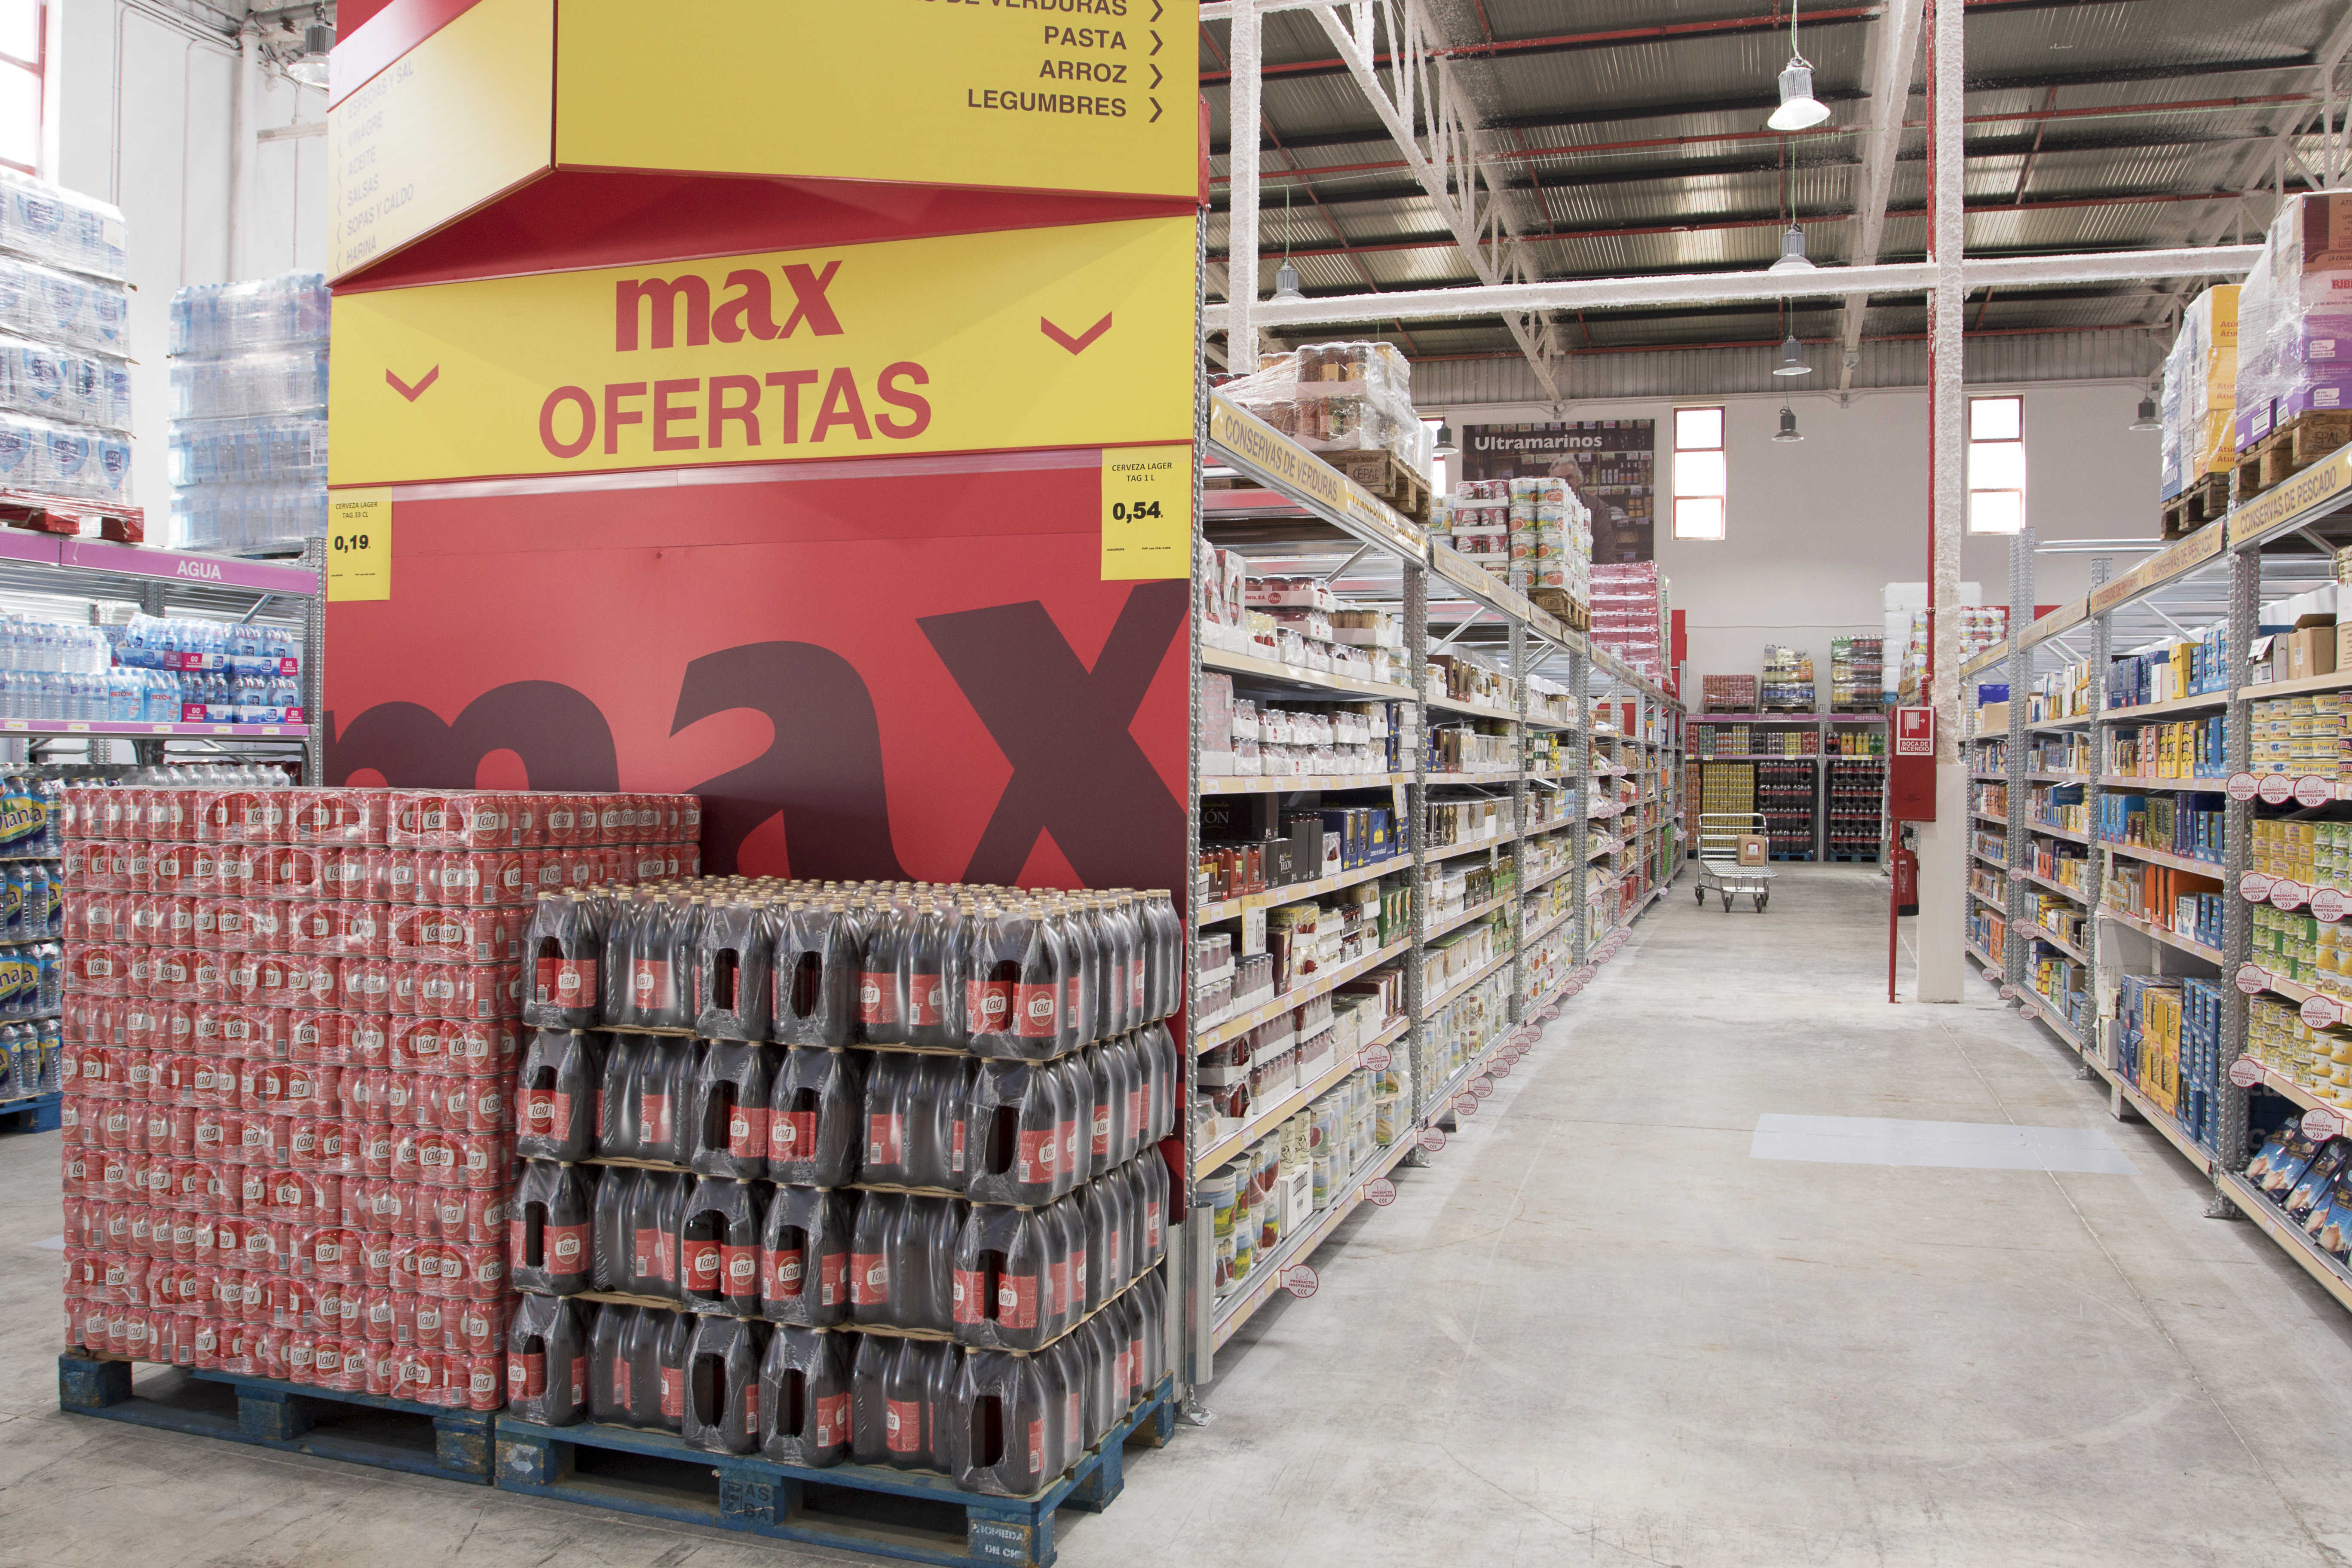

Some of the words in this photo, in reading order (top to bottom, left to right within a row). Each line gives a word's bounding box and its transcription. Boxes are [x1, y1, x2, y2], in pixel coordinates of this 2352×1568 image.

[1044, 25, 1127, 50] PASTA
[1039, 59, 1127, 84] ARROZ
[348, 77, 386, 119] ESPECIAS
[389, 72, 395, 88] Y
[397, 59, 413, 84] SAL
[968, 89, 1127, 118] LEGUMBRES
[348, 110, 383, 147] VINAGRE
[348, 144, 375, 177] ACEITE
[348, 174, 379, 207] SALSAS
[347, 206, 374, 236] SOPAS
[376, 201, 382, 219] Y
[384, 183, 413, 214] CALDO
[347, 235, 377, 266] HARINA
[615, 260, 845, 352] max
[539, 361, 933, 459] OFERTAS
[1475, 434, 1602, 450] Ultramarinos
[1225, 415, 1282, 471] CONSERVAS
[1283, 451, 1295, 479] DE
[1298, 461, 1337, 502] VERDURAS
[2240, 495, 2283, 535] CONSERVAS
[2285, 491, 2296, 513] DE
[2297, 465, 2337, 507] PESCADO
[177, 560, 222, 580] AGUA
[2151, 551, 2180, 579] CONSERVAS
[2181, 547, 2187, 564] DE
[2188, 534, 2212, 560] PESCADO
[638, 974, 649, 986] Tag
[861, 989, 875, 1001] Tag
[1033, 1001, 1050, 1015] Tag
[732, 1122, 744, 1134] Tag
[1097, 1122, 1108, 1134] Tag
[699, 1257, 716, 1269] Tag
[782, 1265, 799, 1279] Tag
